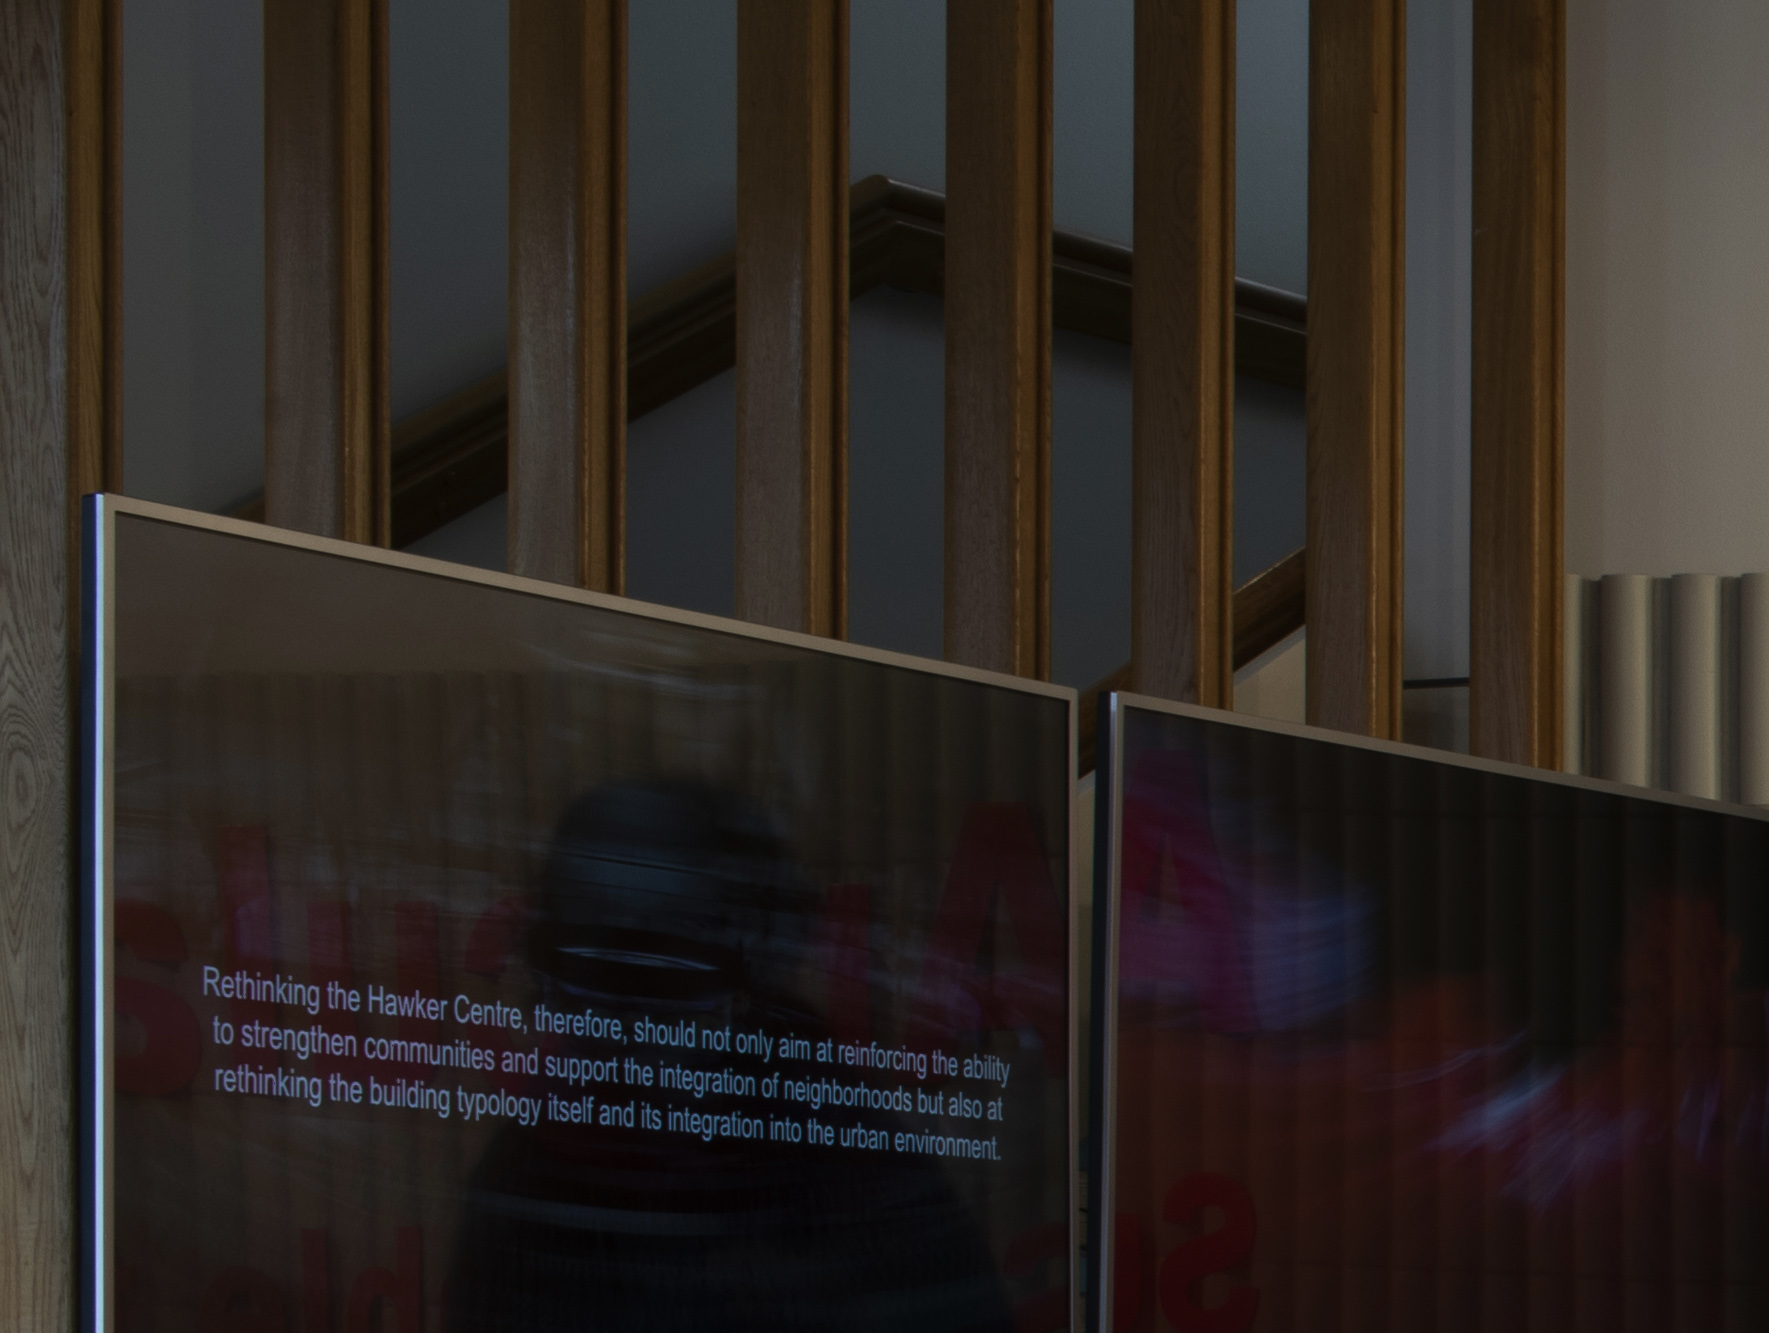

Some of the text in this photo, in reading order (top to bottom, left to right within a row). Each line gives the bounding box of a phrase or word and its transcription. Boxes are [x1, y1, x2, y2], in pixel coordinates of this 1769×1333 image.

[204, 966, 1010, 1088] Rethinking the Hawker Centre, therefore, should not only aim at reinforcing the ability
[213, 1016, 1003, 1121] to strengthen communities and support the integration of neighborhoods but also at
[215, 1064, 1001, 1160] rethinking the building typology itself and its integration into the urban environment.
